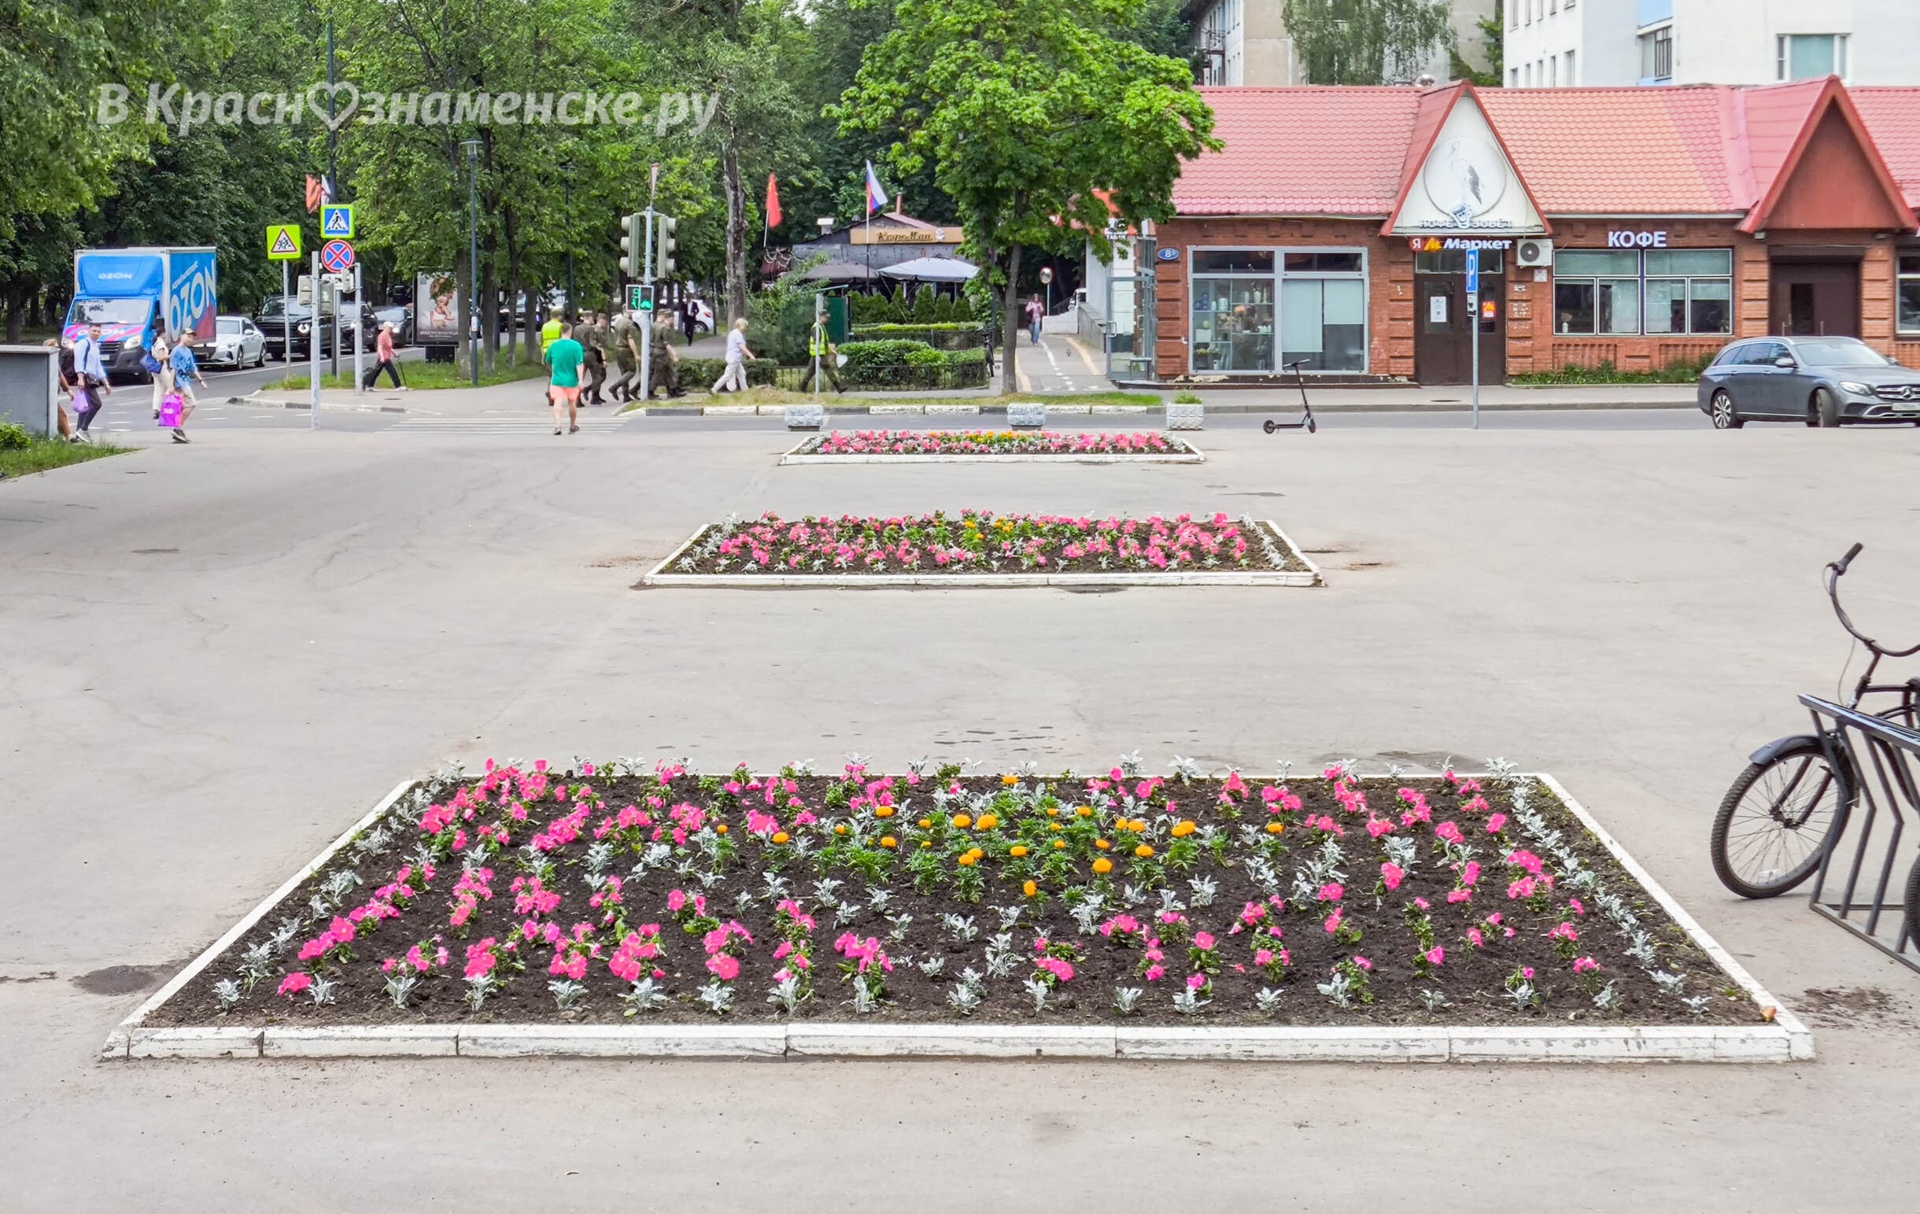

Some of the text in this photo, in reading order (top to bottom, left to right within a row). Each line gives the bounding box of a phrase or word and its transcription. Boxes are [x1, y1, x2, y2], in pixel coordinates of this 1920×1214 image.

[1443, 238, 1512, 250] Маркет
[1608, 231, 1667, 248] КОФЕ
[98, 272, 133, 280] OZON
[170, 258, 216, 342] OZON
